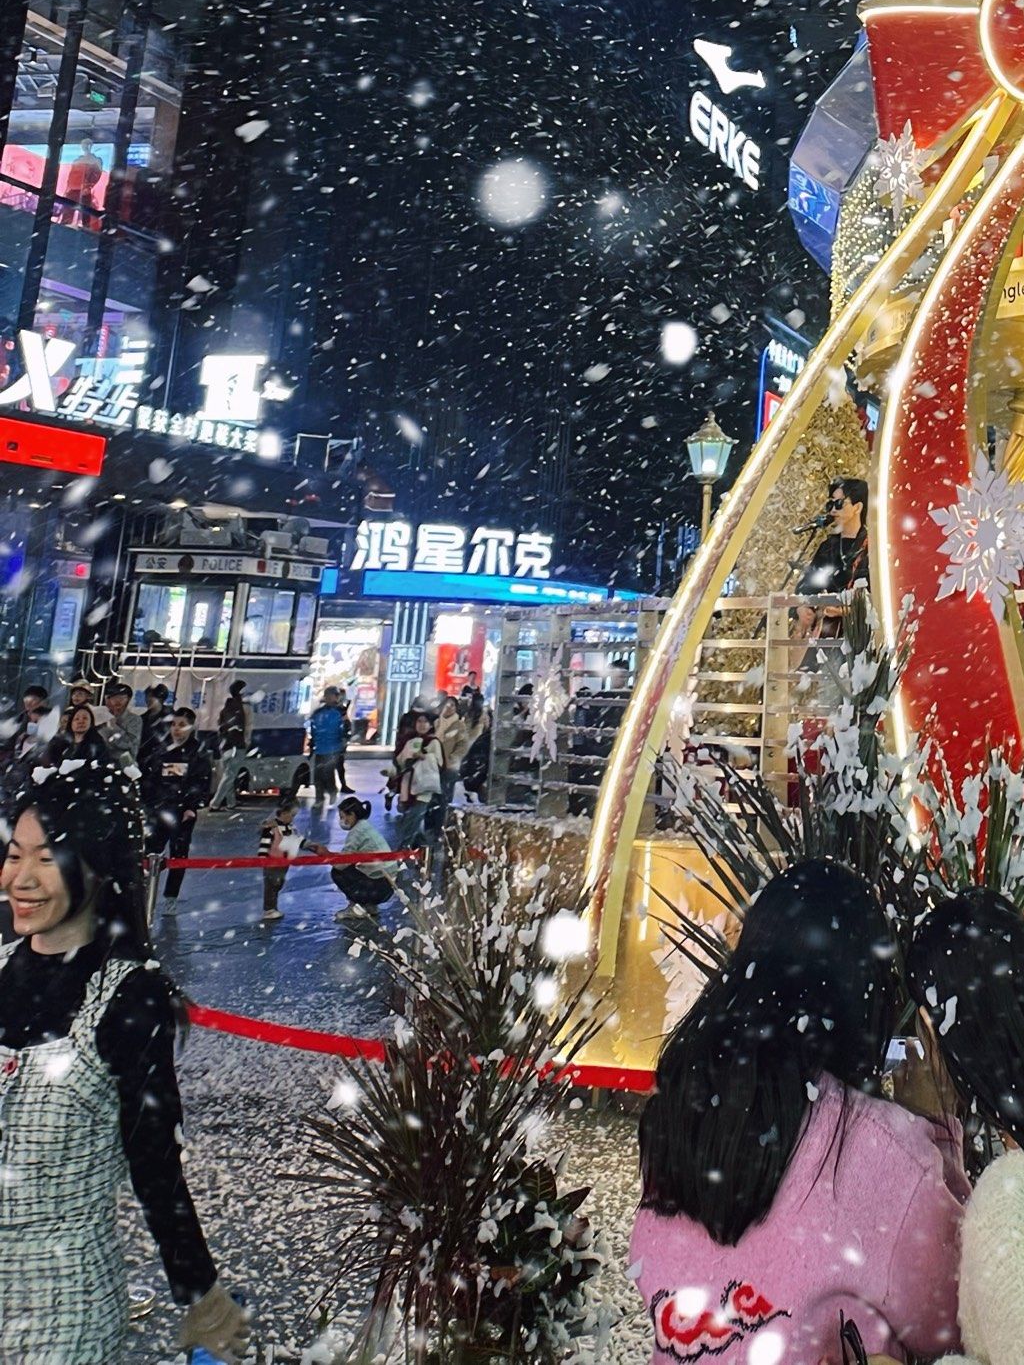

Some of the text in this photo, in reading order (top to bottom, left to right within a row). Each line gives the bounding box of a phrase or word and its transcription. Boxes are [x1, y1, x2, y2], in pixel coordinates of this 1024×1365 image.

[689, 90, 761, 190] ERKE
[201, 559, 243, 571] POLICE
[350, 520, 553, 578] 鸿星尔克
